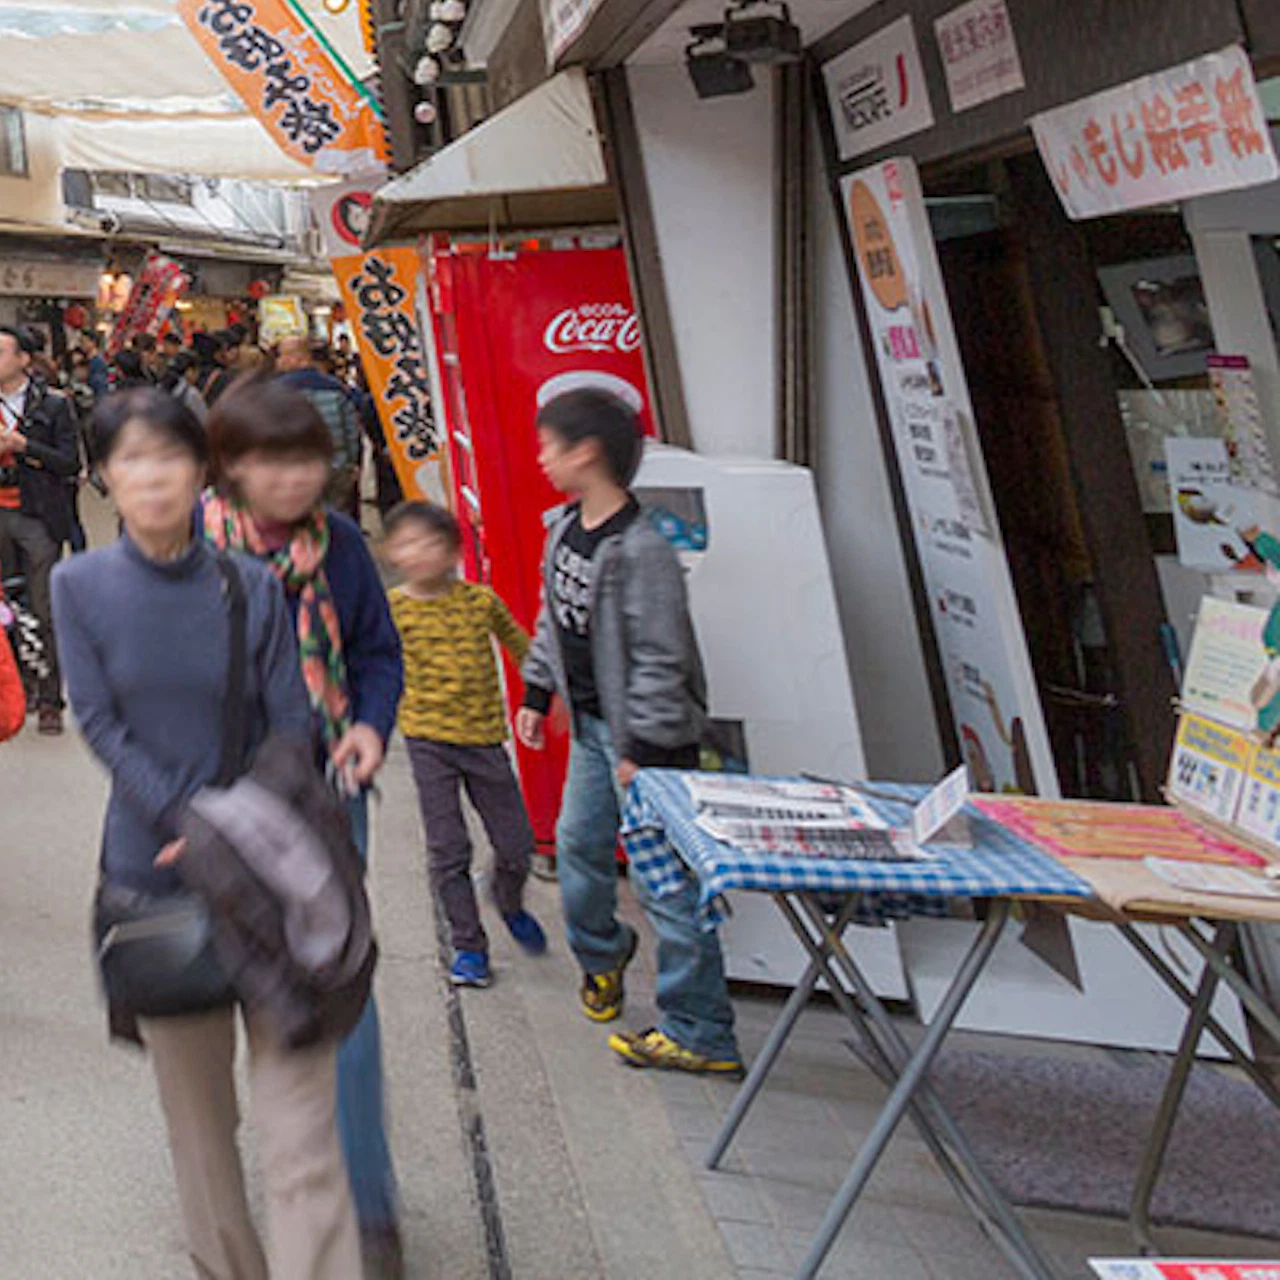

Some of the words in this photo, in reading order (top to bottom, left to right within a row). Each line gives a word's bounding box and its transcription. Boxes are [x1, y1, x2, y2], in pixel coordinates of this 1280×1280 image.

[1044, 66, 1268, 196] しゃもじ絵手紙
[544, 308, 642, 354] Coca-C
